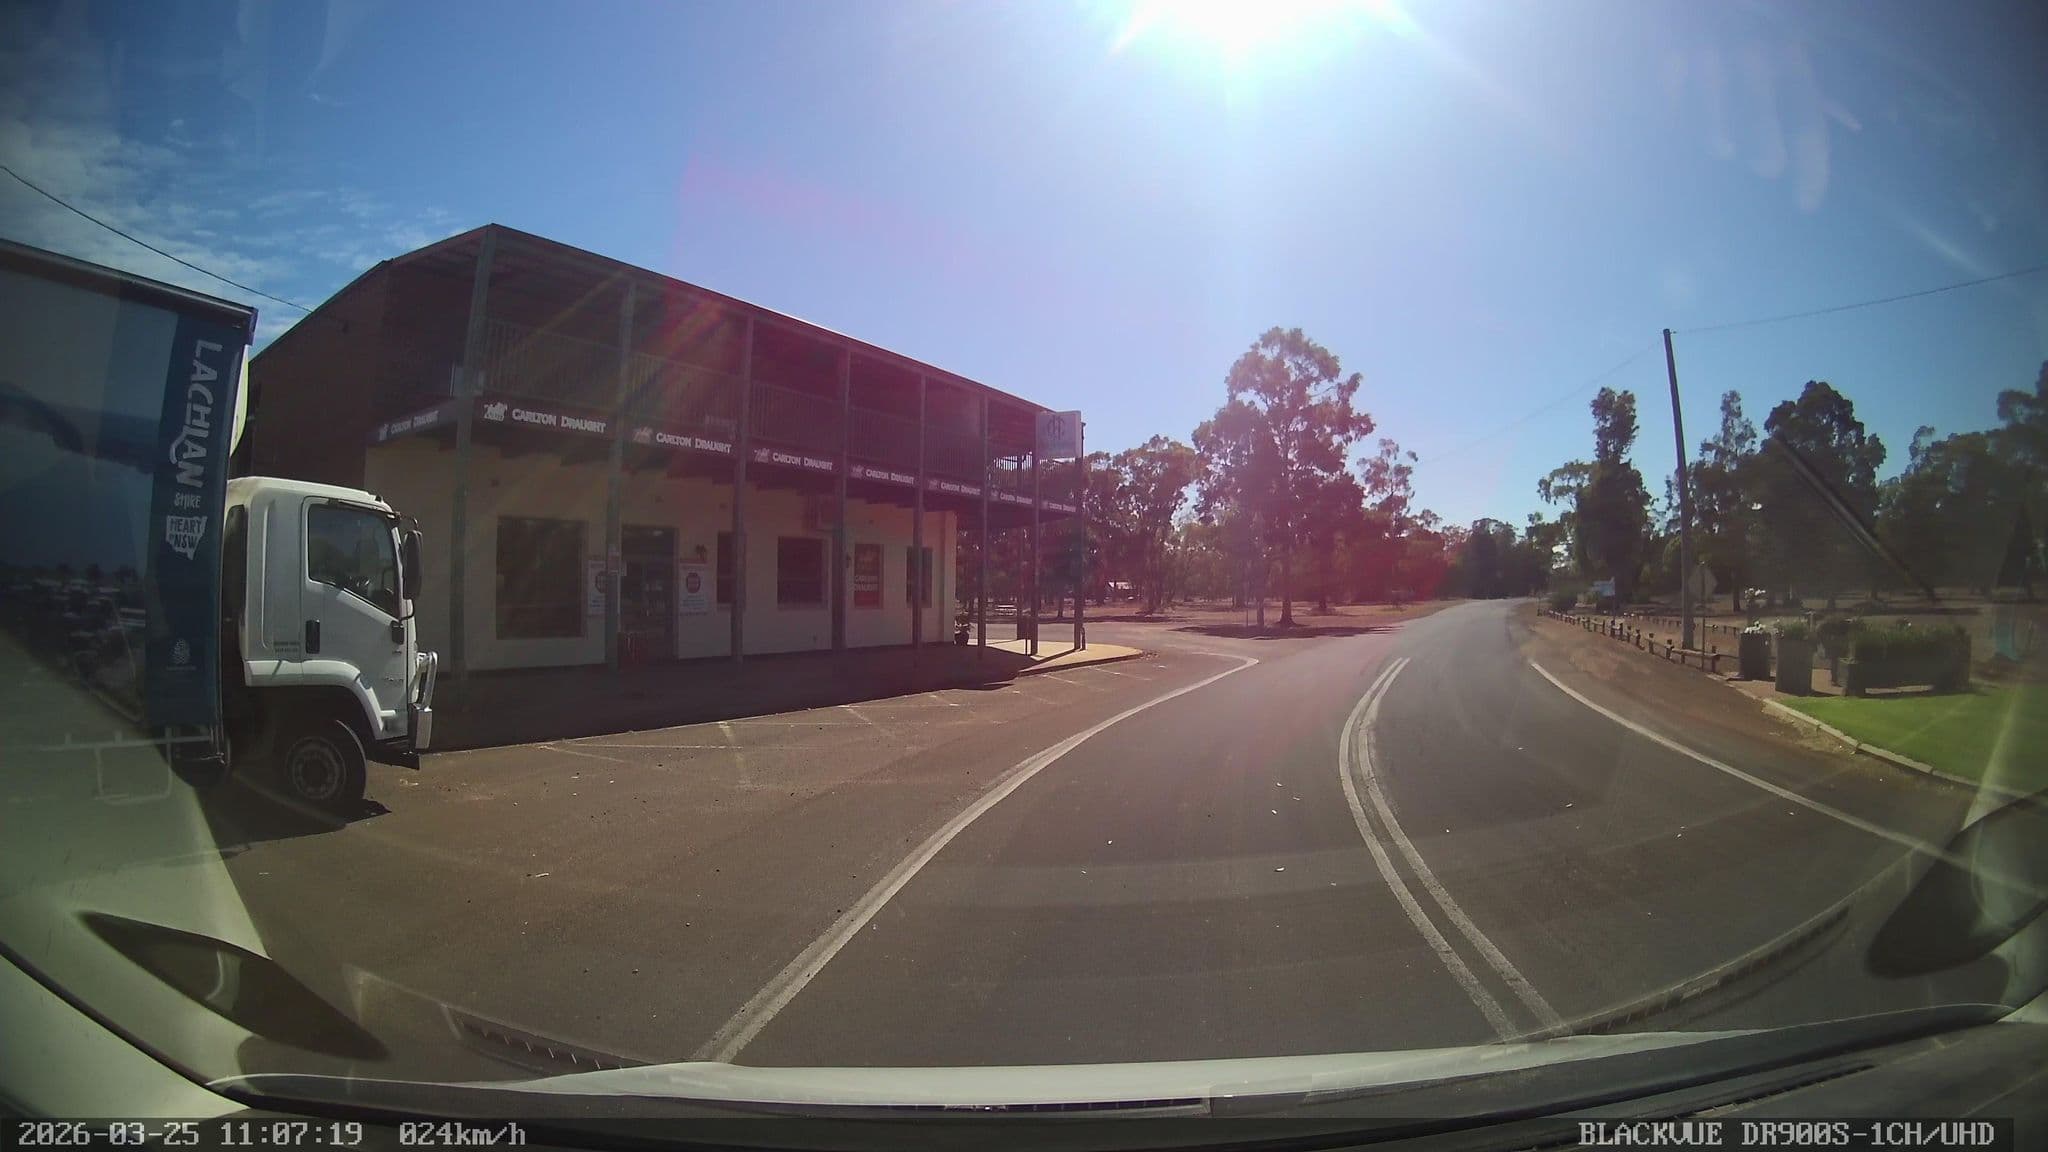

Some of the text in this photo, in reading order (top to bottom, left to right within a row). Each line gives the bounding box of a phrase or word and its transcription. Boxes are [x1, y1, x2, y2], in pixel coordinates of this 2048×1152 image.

[170, 339, 223, 488] LACHLAN
[511, 408, 606, 433] CARLTON DRAUGHT
[655, 432, 732, 453] CARLTON DRAUGHT
[174, 533, 198, 549] NSW
